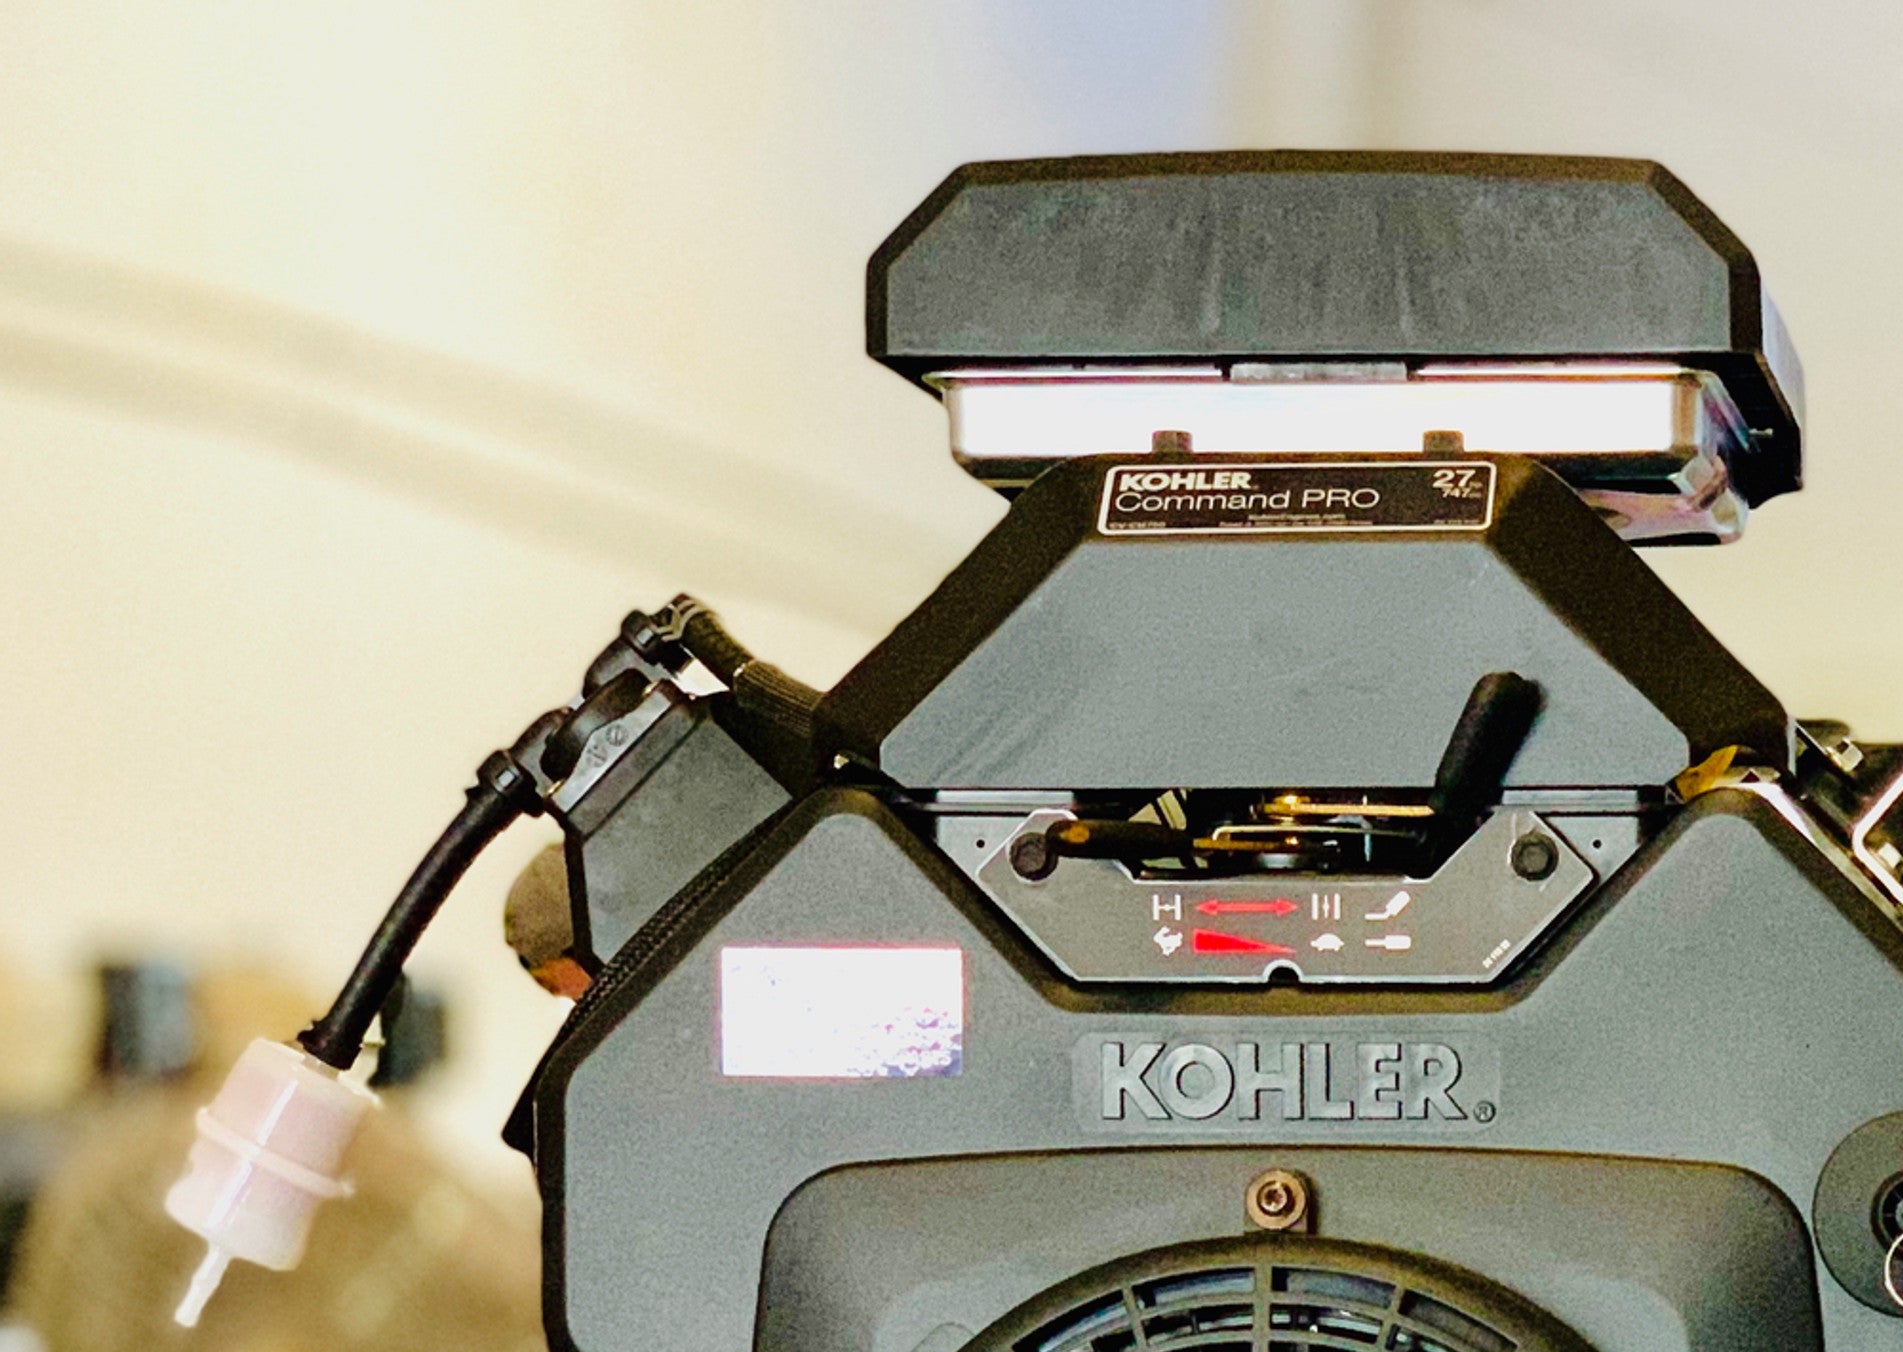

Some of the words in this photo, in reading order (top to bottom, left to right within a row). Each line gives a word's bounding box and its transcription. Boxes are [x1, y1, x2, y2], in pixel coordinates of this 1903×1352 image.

[1119, 472, 1252, 491] KOHLER
[1432, 469, 1476, 488] 27
[1115, 489, 1291, 511] Command
[1302, 487, 1380, 509] PRO
